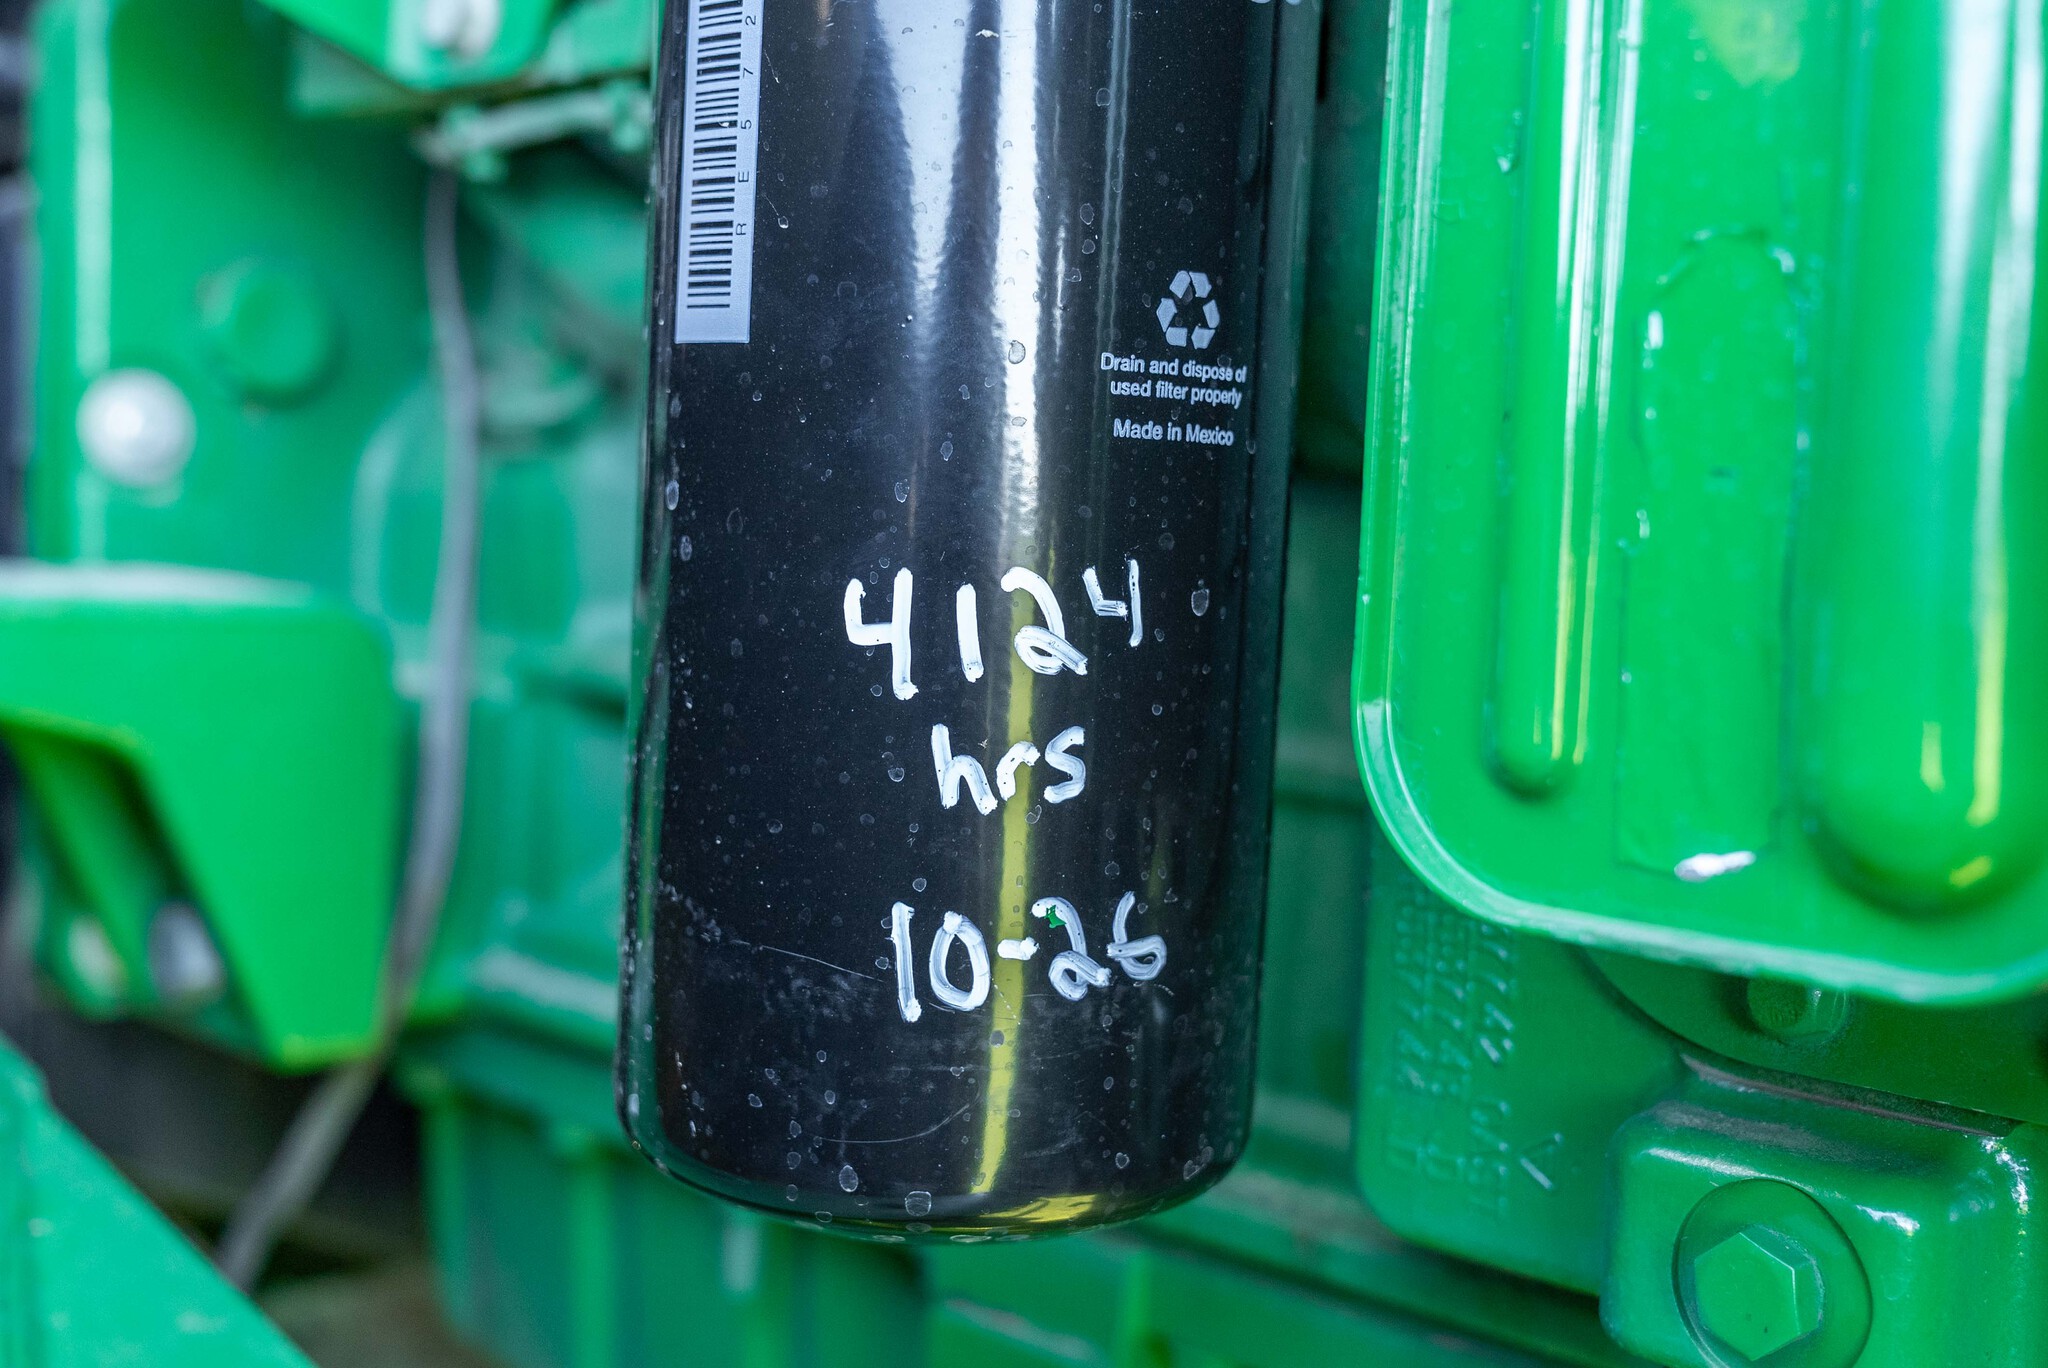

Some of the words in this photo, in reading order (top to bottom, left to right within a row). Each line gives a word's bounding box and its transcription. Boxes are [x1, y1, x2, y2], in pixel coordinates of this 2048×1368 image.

[1101, 352, 1145, 373] Drain
[1150, 358, 1178, 376] and
[1183, 360, 1232, 383] dispose
[1235, 365, 1247, 384] of
[1111, 380, 1151, 397] used
[1155, 381, 1188, 400] filter
[1191, 388, 1242, 409] properly
[1113, 418, 1163, 440] Made
[1168, 422, 1182, 441] in
[1186, 423, 1234, 446] Mexico
[842, 557, 1144, 701] 4124
[930, 723, 1087, 816] hrs
[890, 891, 1168, 1024] 10-26
